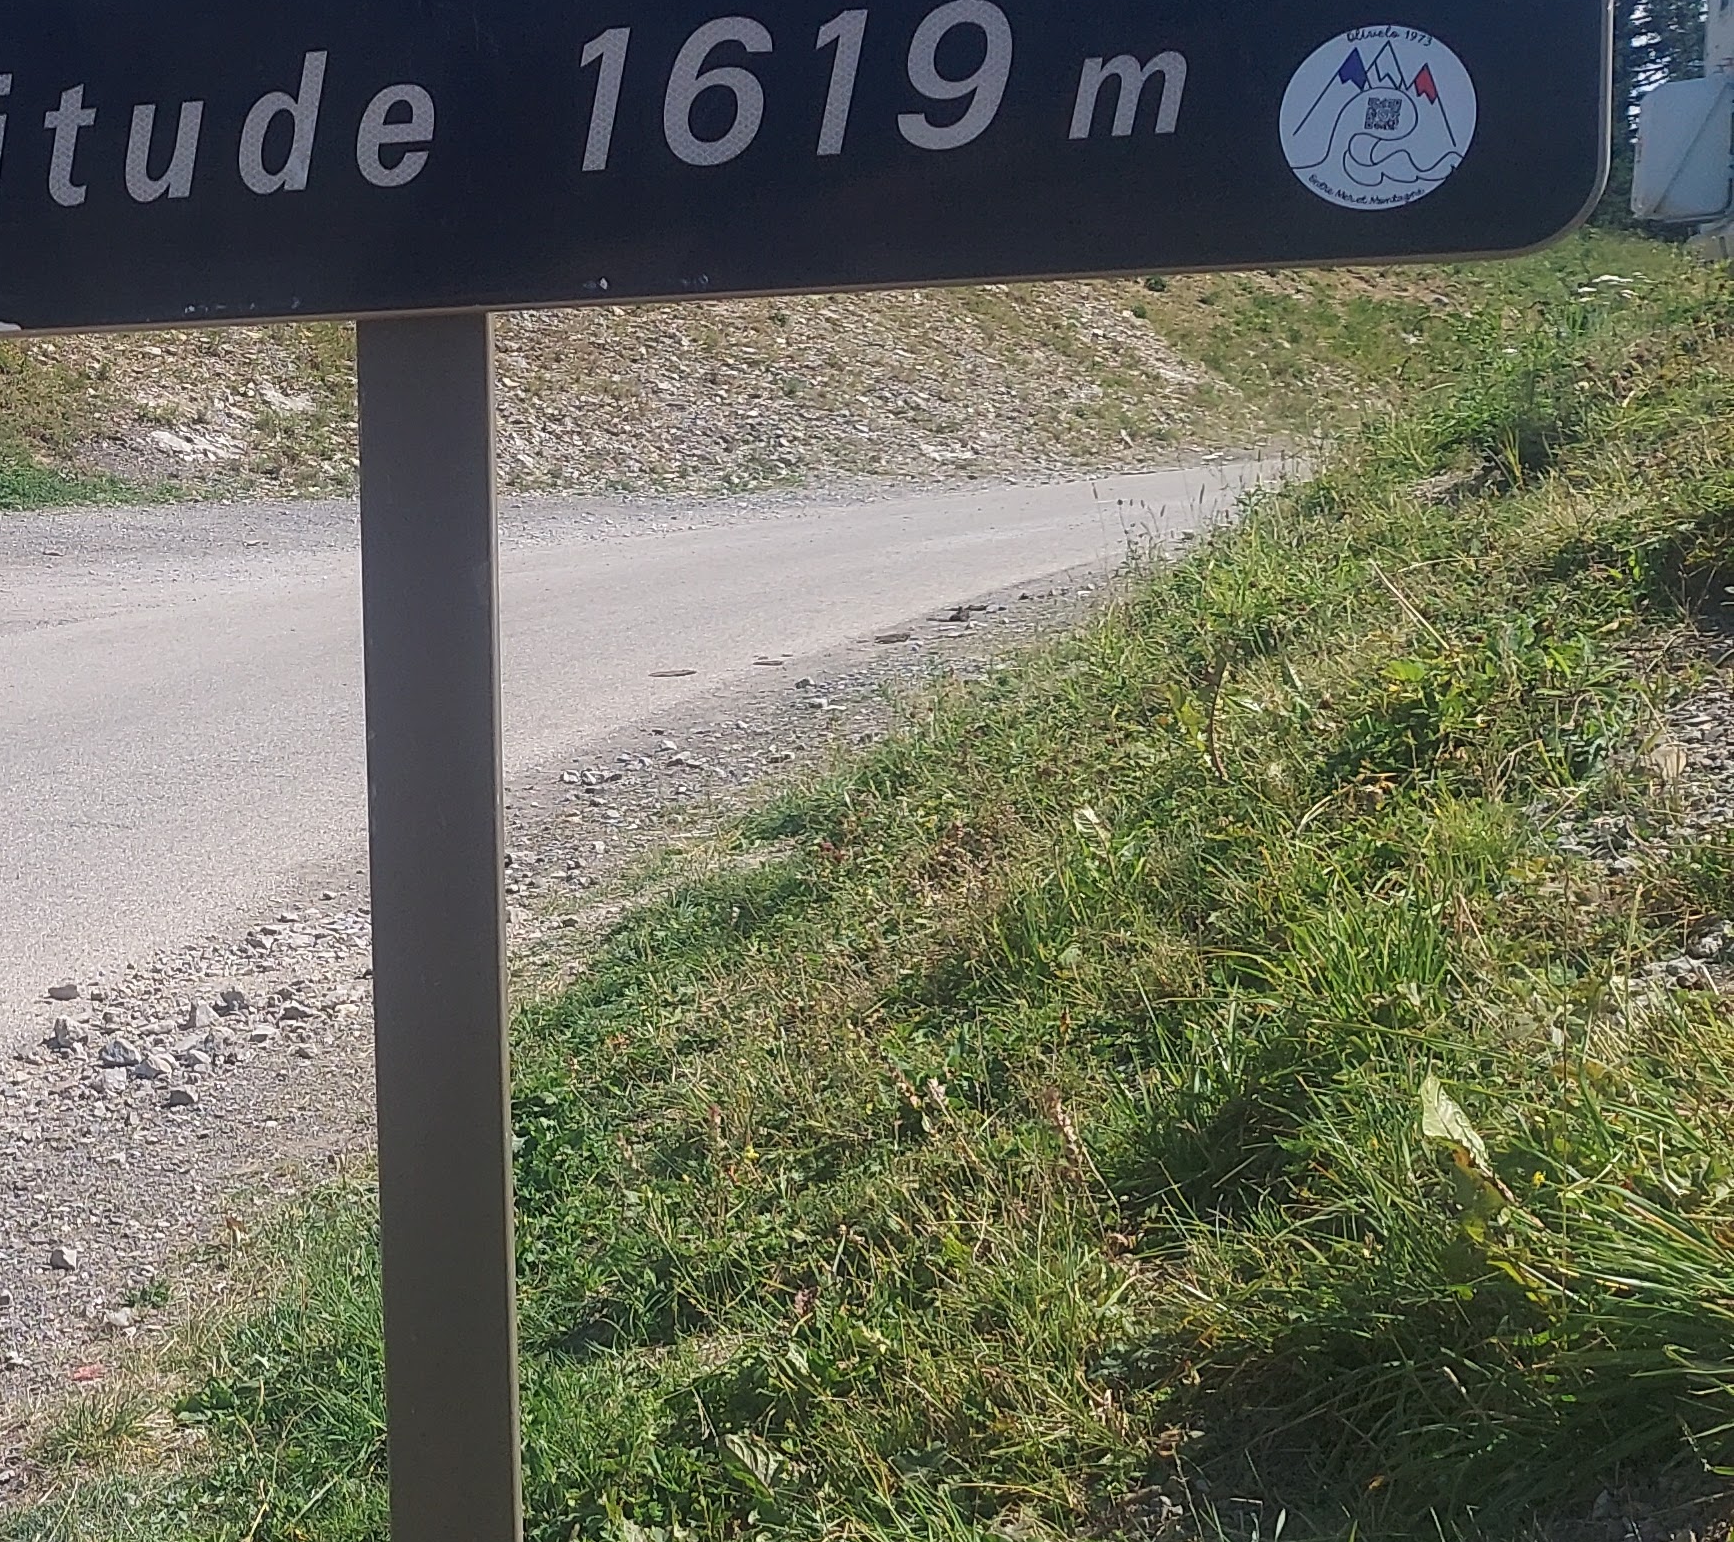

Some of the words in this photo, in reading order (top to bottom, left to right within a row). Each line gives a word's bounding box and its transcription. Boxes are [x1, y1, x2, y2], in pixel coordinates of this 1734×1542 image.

[580, 0, 1014, 171] 1619
[1068, 51, 1188, 141] m
[1405, 30, 1433, 47] 1973
